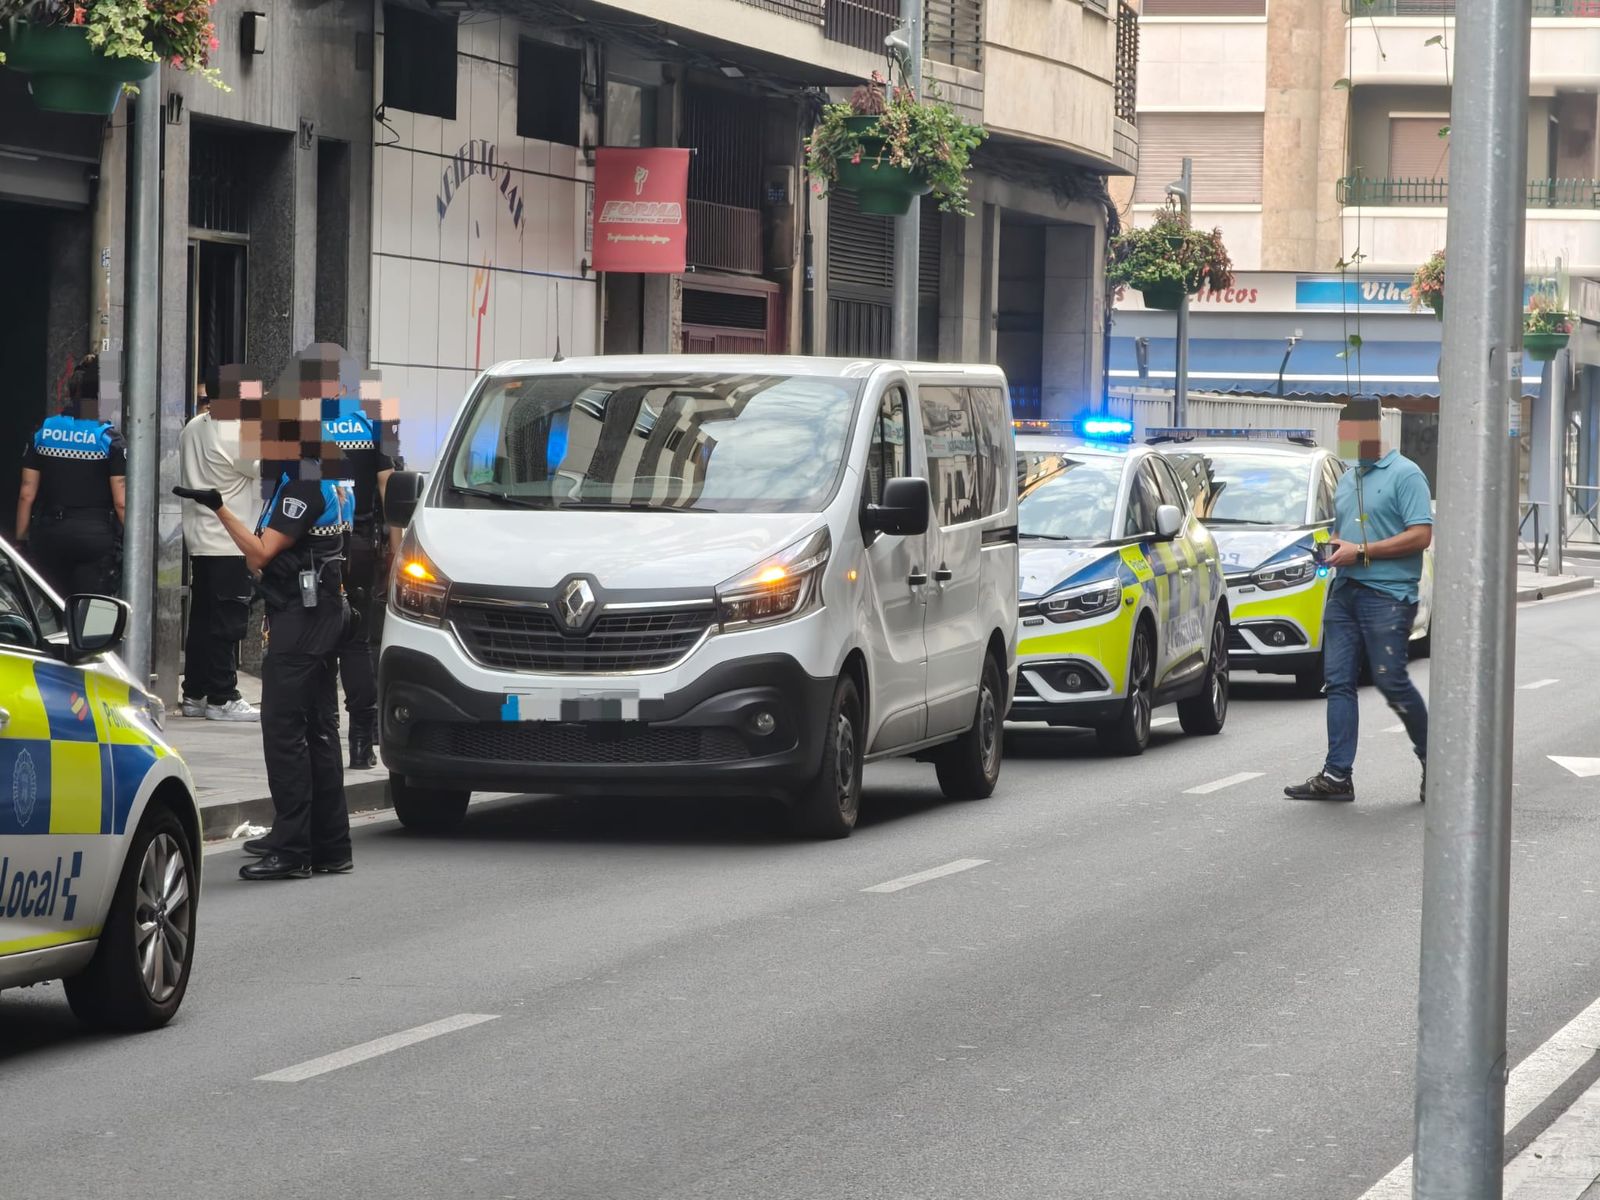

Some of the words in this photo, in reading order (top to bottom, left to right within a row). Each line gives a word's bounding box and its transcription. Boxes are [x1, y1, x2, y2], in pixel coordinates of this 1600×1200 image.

[602, 201, 681, 218] FORMA
[326, 419, 364, 434] LICÍA
[42, 428, 97, 445] POLICÍA
[0, 856, 62, 918] Local
